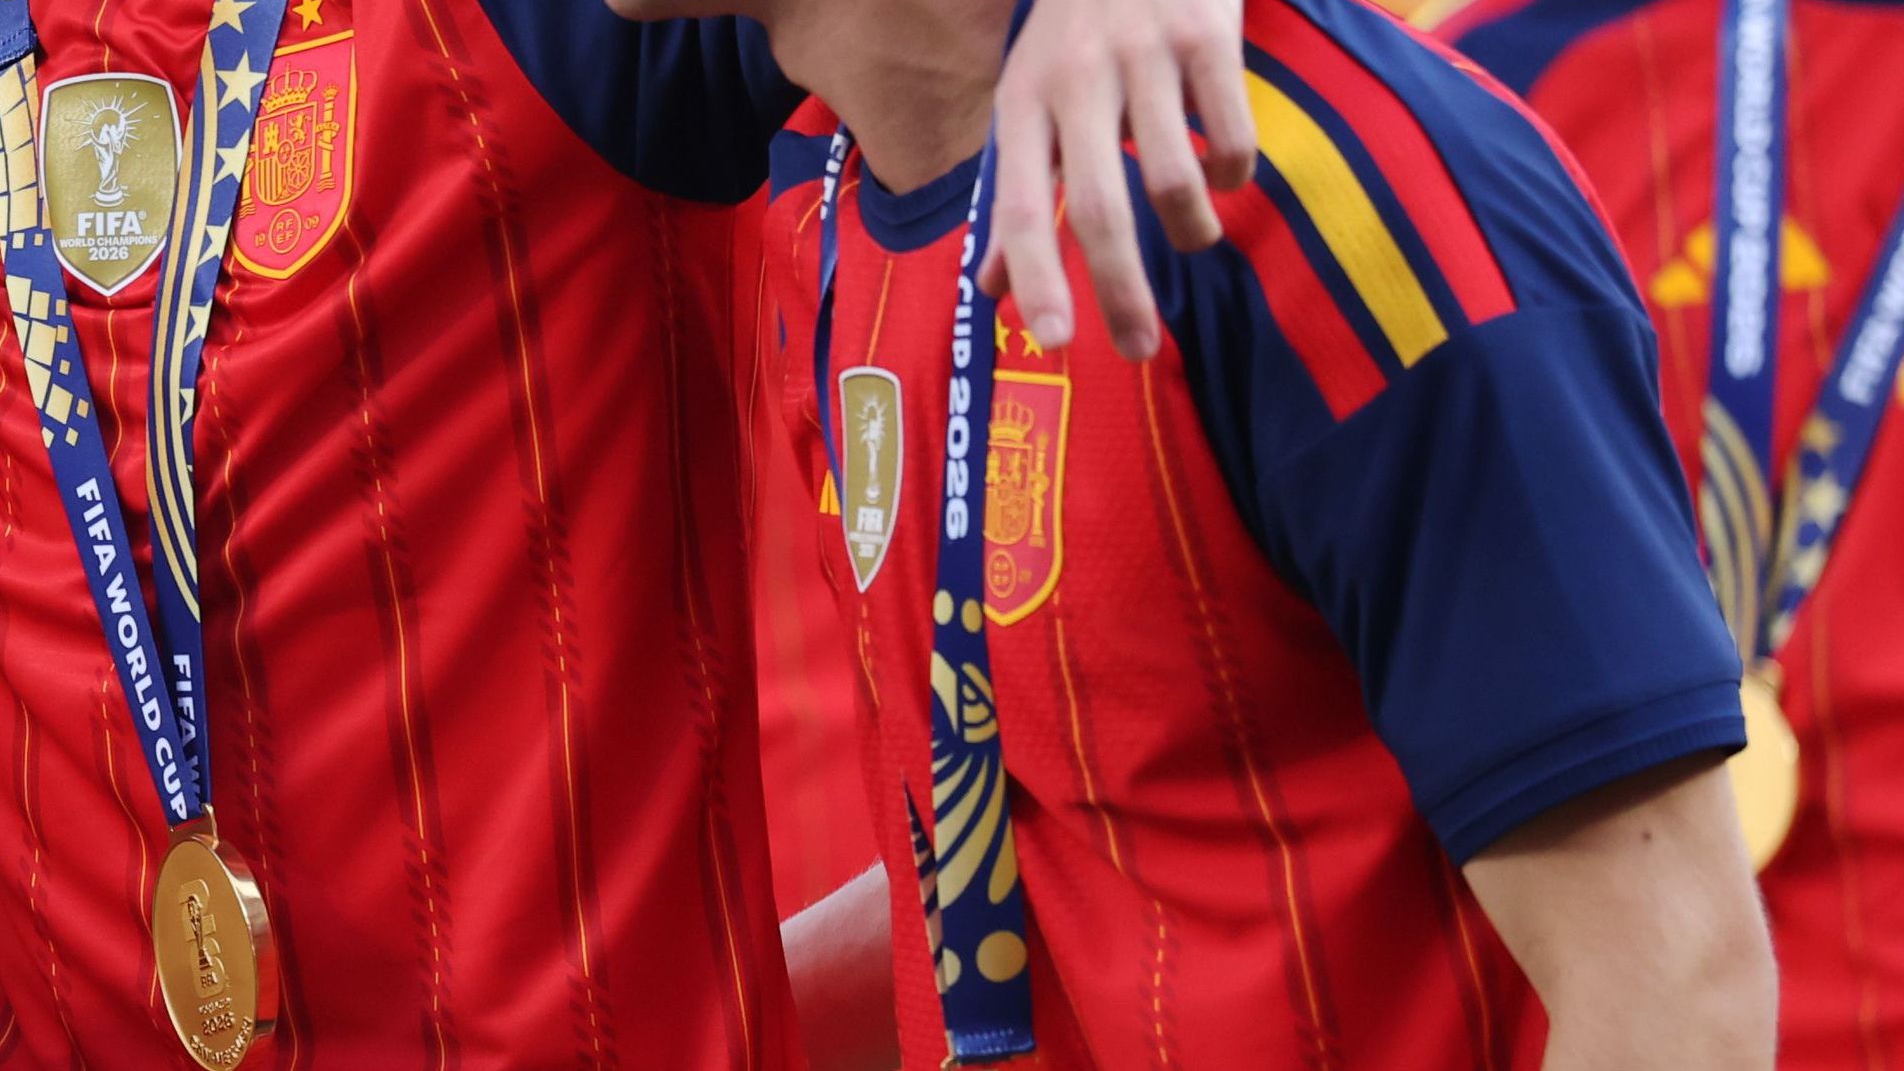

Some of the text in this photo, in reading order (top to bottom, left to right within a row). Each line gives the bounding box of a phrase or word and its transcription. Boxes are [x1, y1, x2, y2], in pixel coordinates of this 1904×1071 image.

[60, 235, 158, 248] WORLD CHAMPIONS
[78, 211, 142, 236] FIFA
[89, 247, 129, 261] 2026
[946, 376, 971, 540] 2026
[76, 478, 187, 820] FIFA WORLD CUP
[173, 654, 196, 747] FIFA
